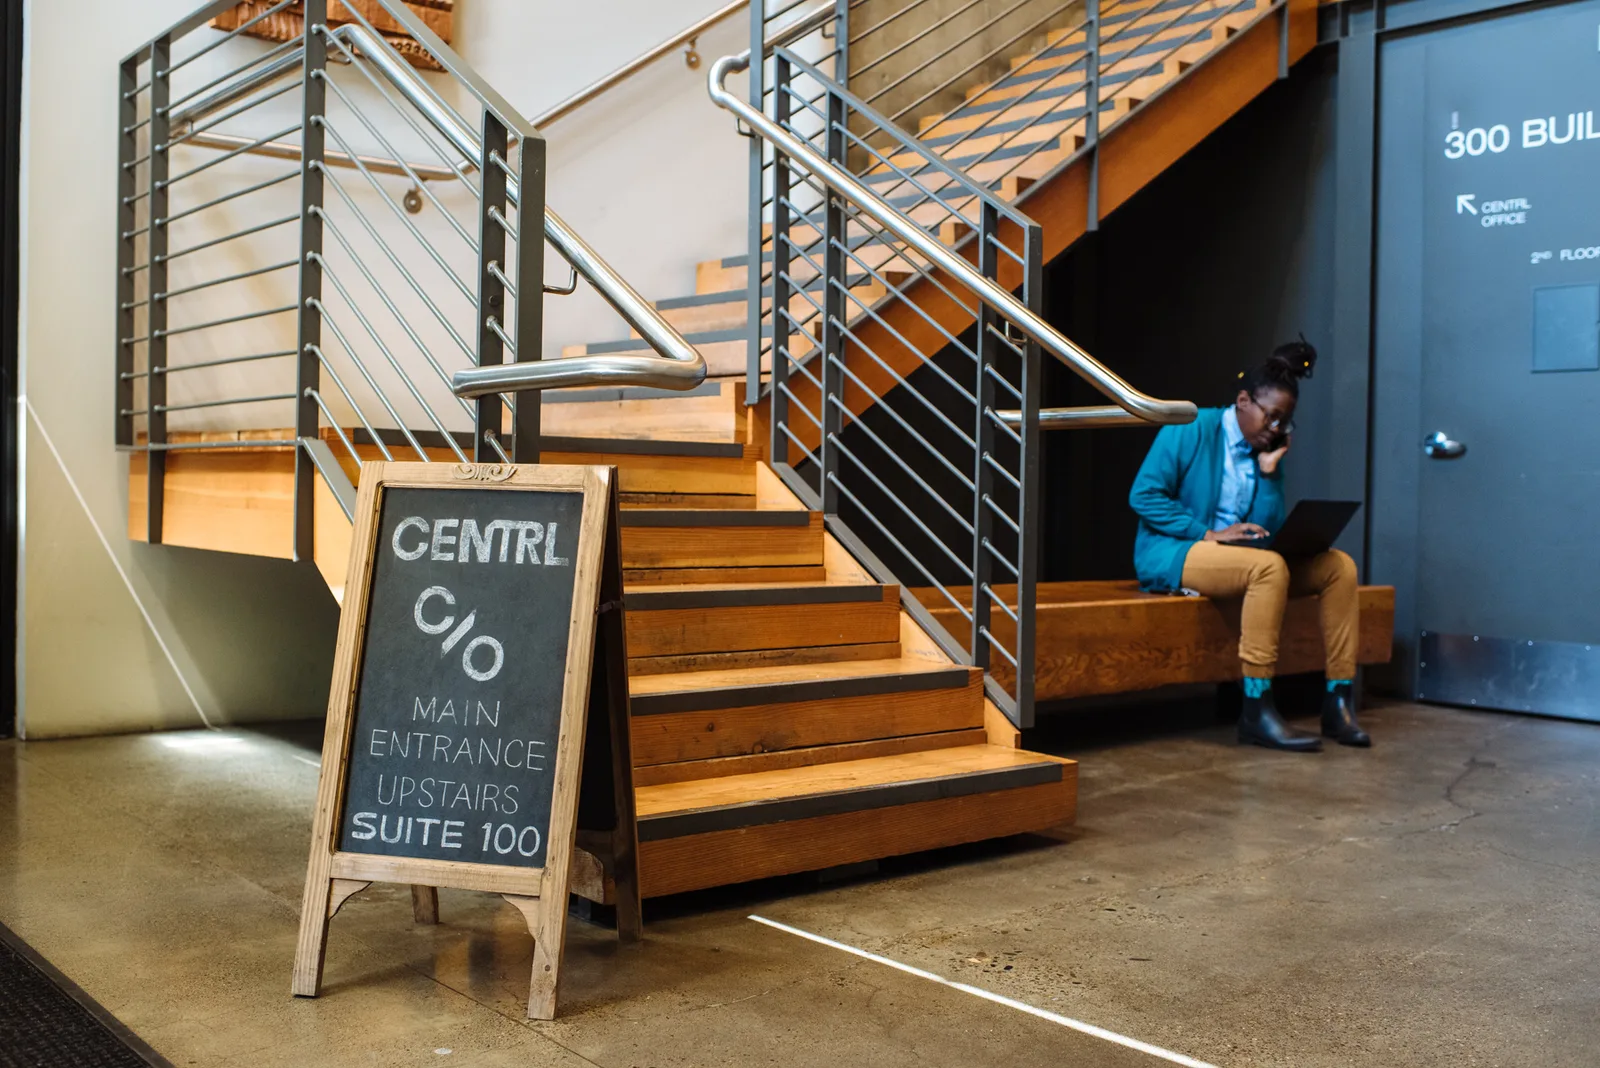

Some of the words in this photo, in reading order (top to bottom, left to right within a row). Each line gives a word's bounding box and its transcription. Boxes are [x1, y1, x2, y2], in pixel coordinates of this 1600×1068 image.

[1444, 124, 1510, 160] 300
[1522, 110, 1600, 149] BUIL
[1481, 211, 1527, 228] OFFICE
[391, 516, 570, 566] CENTRL
[412, 696, 501, 728] MAIN
[369, 728, 546, 771] ENTRANCE
[377, 773, 520, 815] UPSTAIRS
[351, 811, 465, 849] SUITE
[481, 822, 541, 857] 100
